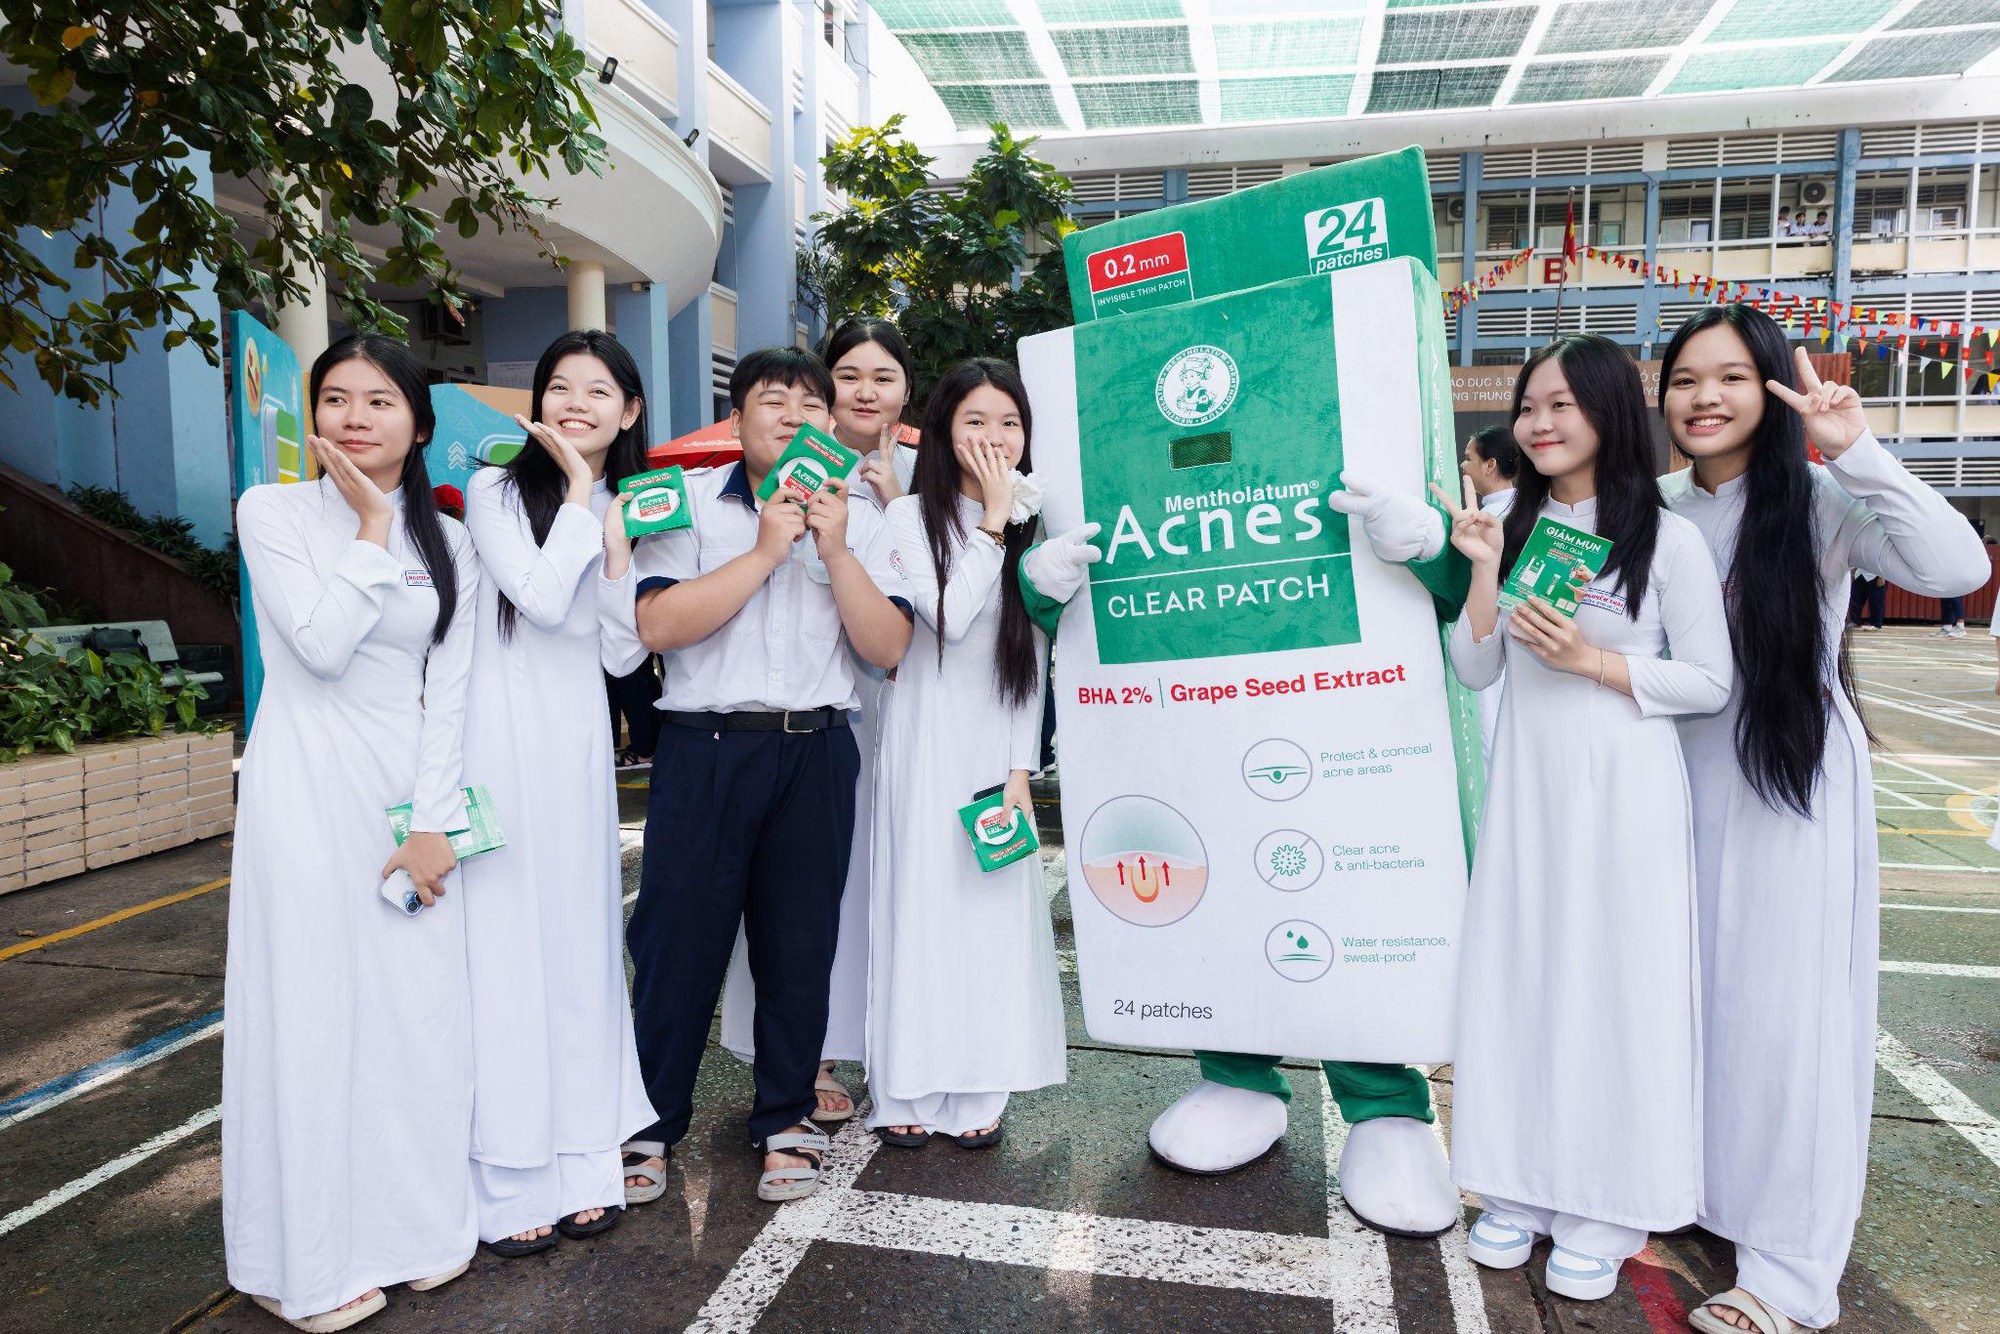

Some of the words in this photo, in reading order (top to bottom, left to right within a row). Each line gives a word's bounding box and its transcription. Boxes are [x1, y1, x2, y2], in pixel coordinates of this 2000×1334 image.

[1317, 201, 1377, 255] 24
[1104, 254, 1137, 279] 0.2
[1139, 254, 1170, 271] mm
[1316, 247, 1384, 275] patches
[1544, 258, 1568, 284] B
[1097, 290, 1136, 307] INVISIBLE
[1137, 285, 1157, 297] THIN
[1158, 278, 1186, 292] PATCH
[1495, 377, 1502, 387] &
[1451, 391, 1469, 401] NG
[1472, 391, 1511, 402] TRUNG
[1105, 497, 1323, 565] Acnes
[1107, 586, 1206, 618] CLEAR
[1217, 573, 1330, 608] PATCH
[1078, 686, 1117, 705] BHA
[1121, 685, 1153, 705] 2%
[1170, 682, 1238, 705] Grape
[1245, 674, 1306, 698] Seed
[1314, 664, 1406, 691] Extract
[1320, 749, 1366, 763] Protect
[1368, 748, 1378, 759] &
[1381, 742, 1433, 758] conceal
[1322, 768, 1354, 779] acne
[1357, 764, 1393, 776] areas
[1332, 845, 1364, 857] Clear
[1369, 844, 1400, 855] acne
[1334, 860, 1344, 872] &
[1347, 857, 1425, 871] anti-bacteria
[1341, 936, 1378, 948] Water
[1381, 934, 1450, 948] resistance,
[1343, 951, 1418, 965] sweat-proof
[1113, 999, 1136, 1016] 24
[1141, 1000, 1213, 1021] patches
